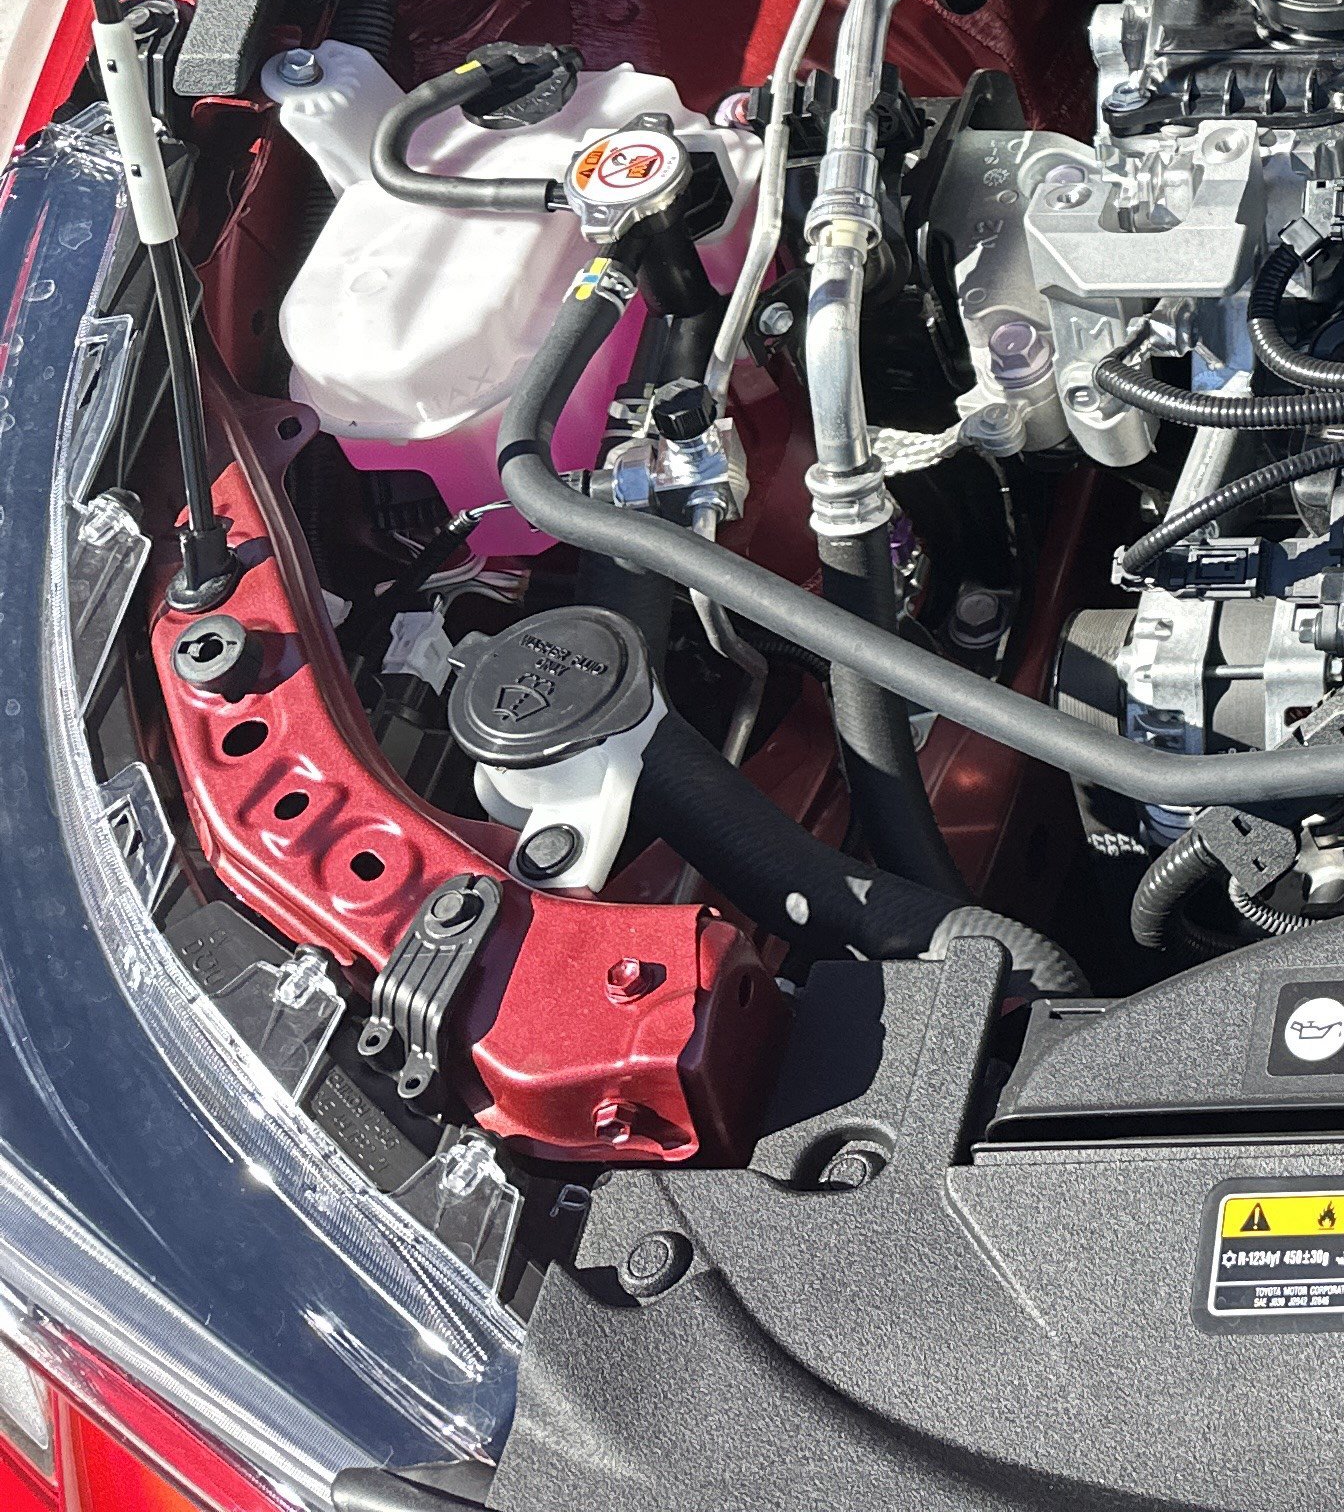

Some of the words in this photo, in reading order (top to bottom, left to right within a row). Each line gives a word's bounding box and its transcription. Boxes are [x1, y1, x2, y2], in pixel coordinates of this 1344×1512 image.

[534, 656, 570, 676] ONLY
[570, 654, 608, 676] FLUID
[1237, 1250, 1281, 1268] R-1234yf
[1255, 1286, 1281, 1297] TOYOTA
[1283, 1285, 1308, 1296] MOTOR
[1254, 1298, 1267, 1308] SAE
